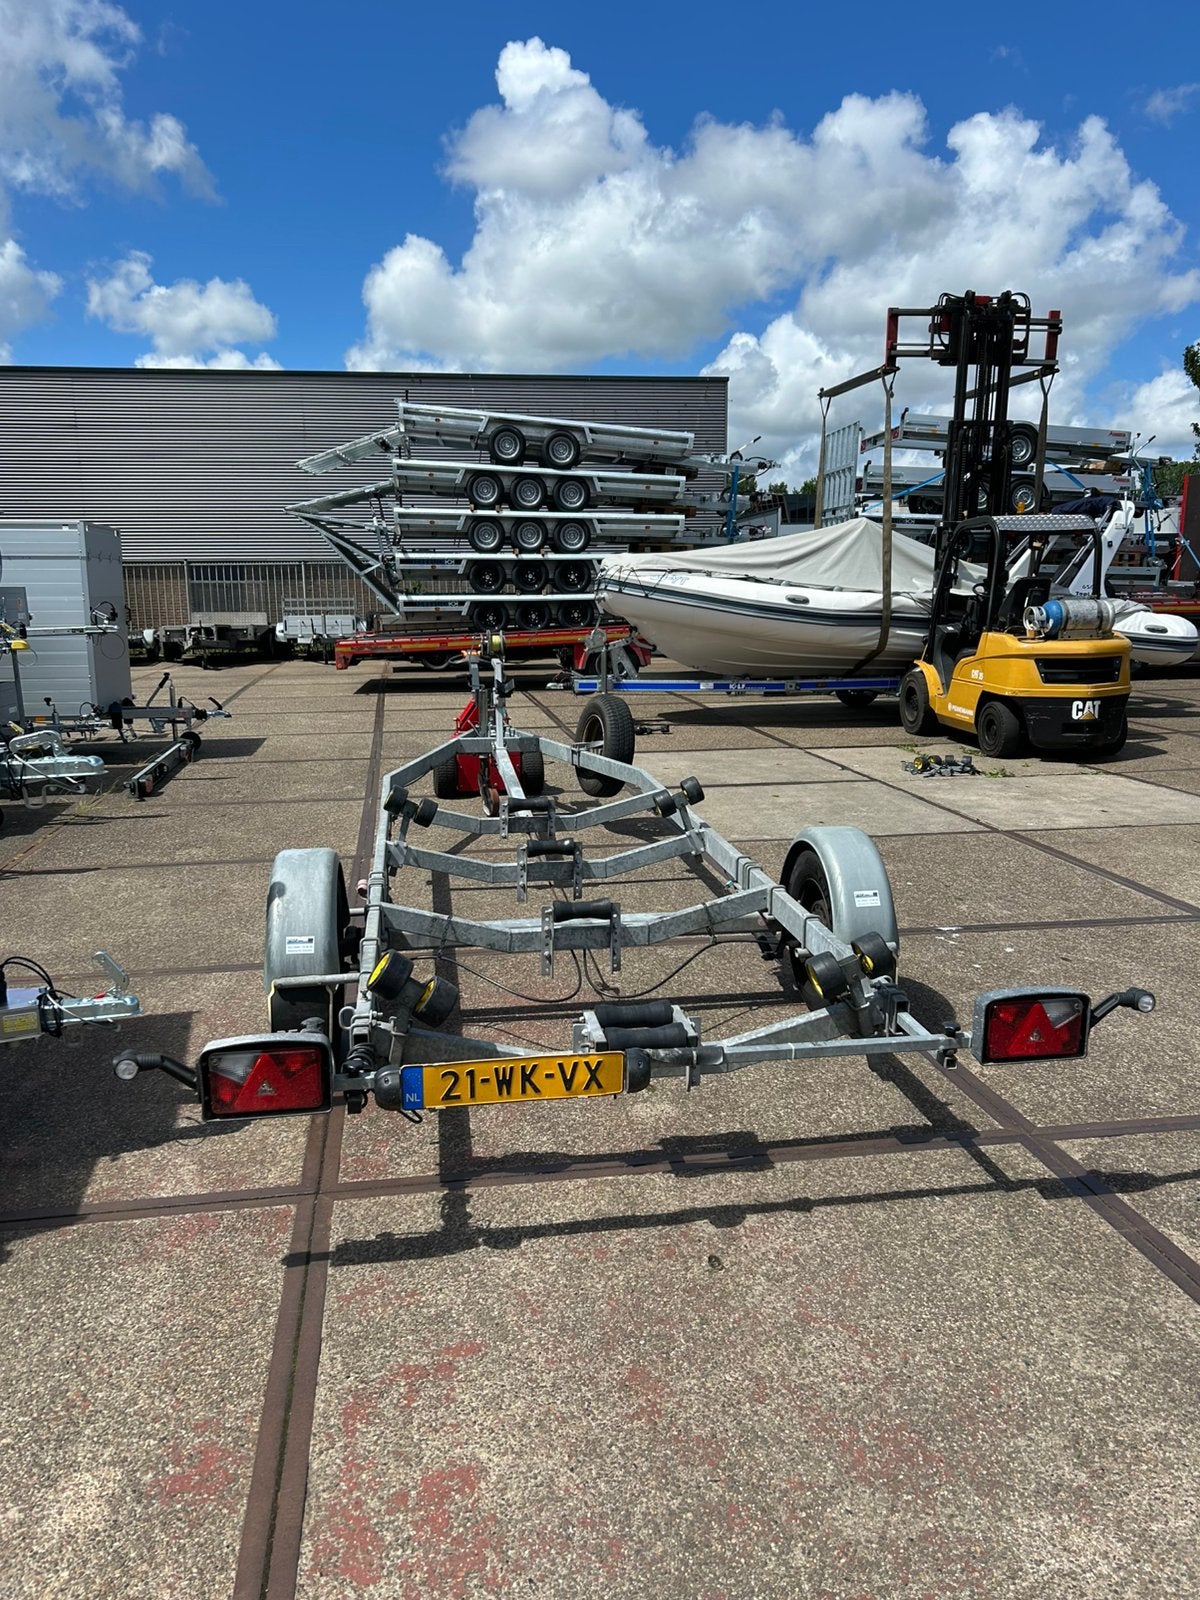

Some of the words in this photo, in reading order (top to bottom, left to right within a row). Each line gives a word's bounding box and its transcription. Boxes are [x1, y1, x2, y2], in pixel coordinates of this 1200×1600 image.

[1071, 700, 1101, 720] CAT
[440, 1059, 604, 1102] 21-WK-VX
[405, 1093, 421, 1103] NL
